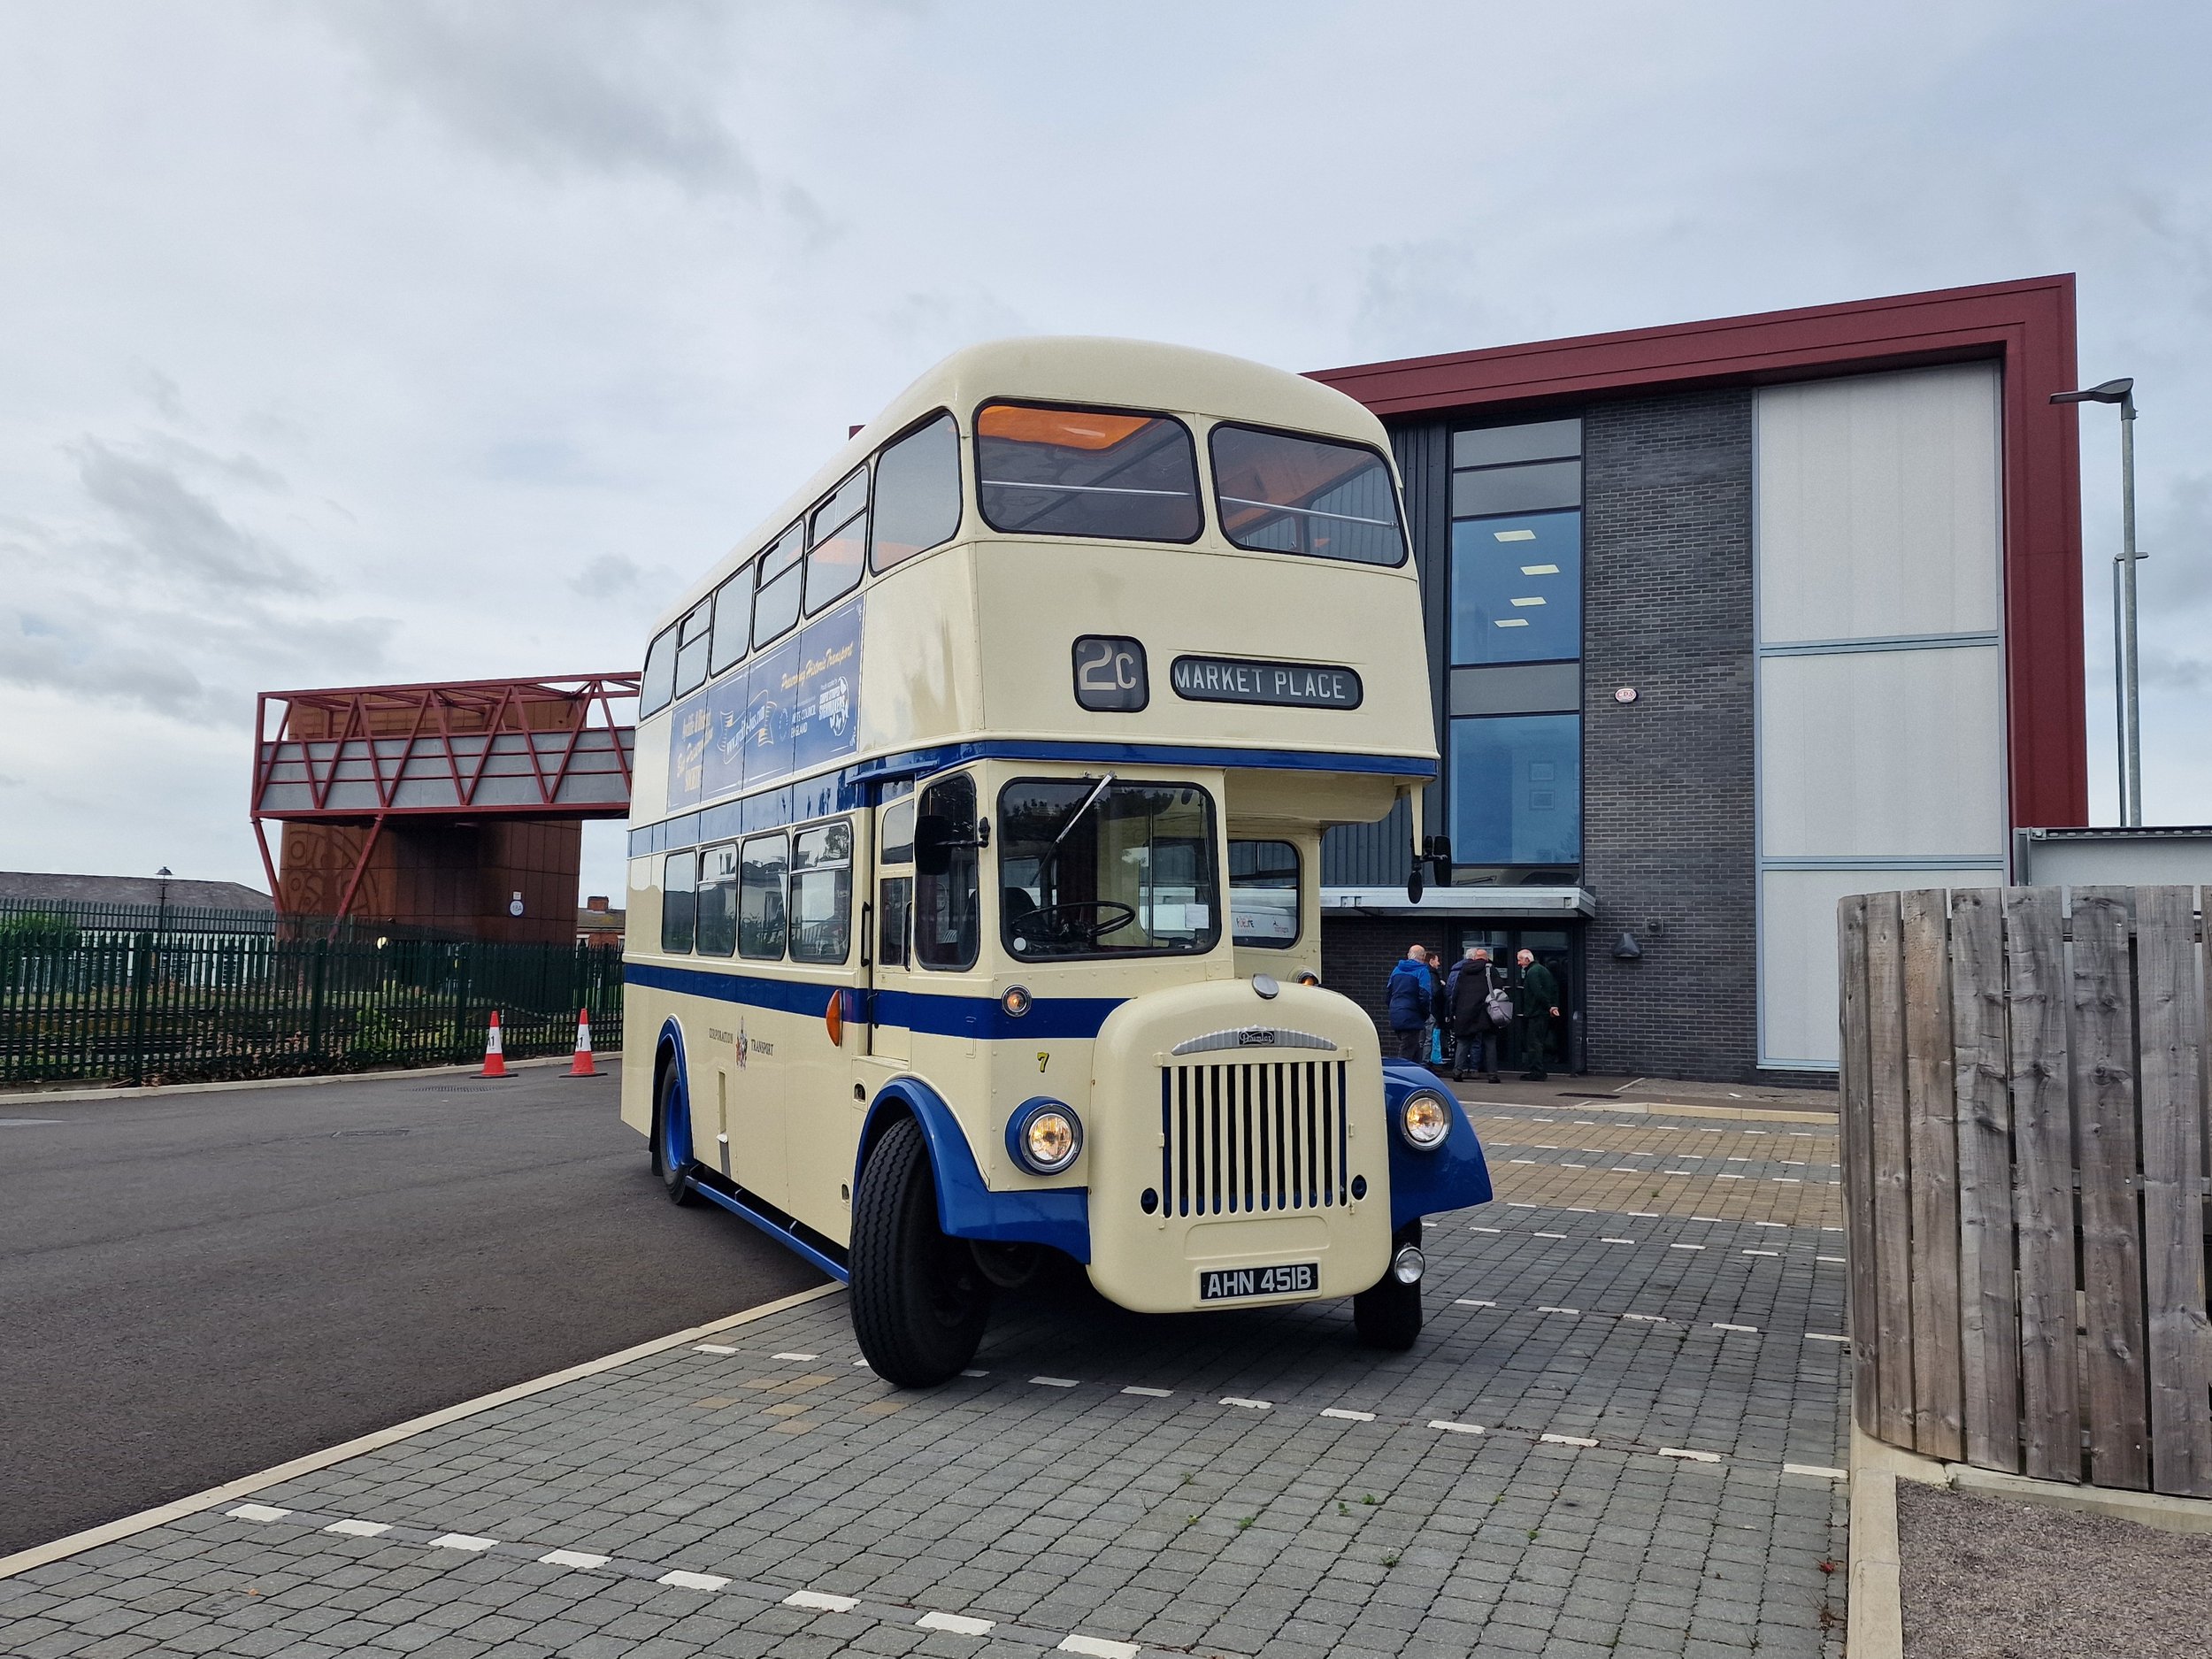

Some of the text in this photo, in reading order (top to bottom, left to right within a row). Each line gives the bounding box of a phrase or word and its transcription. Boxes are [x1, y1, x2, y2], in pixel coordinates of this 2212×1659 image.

[1174, 664, 1346, 699] MARKET PLACE
[750, 1039, 774, 1056] TRANSPORT
[1036, 1051, 1050, 1073] 7
[1207, 1265, 1312, 1297] AHN 451B
